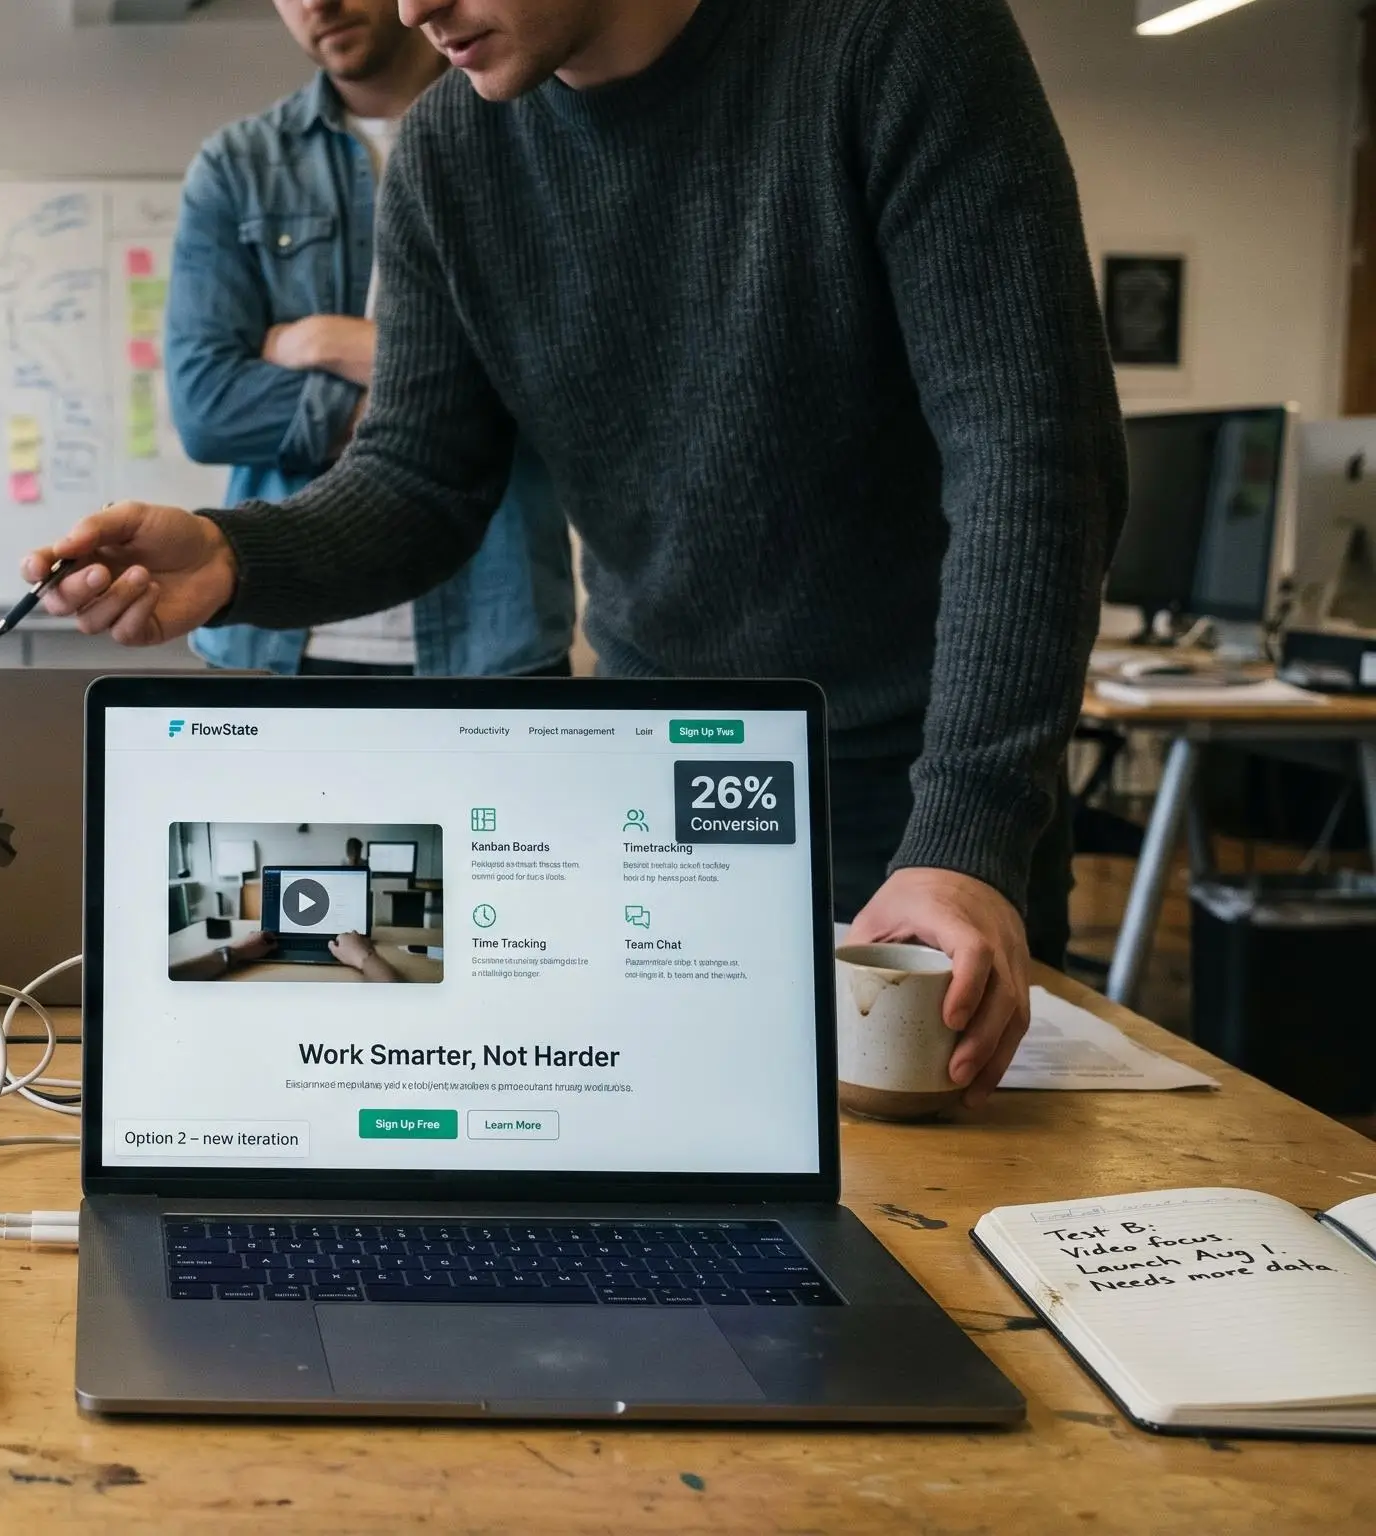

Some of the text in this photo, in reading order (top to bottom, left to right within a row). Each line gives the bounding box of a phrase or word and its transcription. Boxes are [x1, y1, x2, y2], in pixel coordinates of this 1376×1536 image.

[192, 723, 258, 735] FlowState
[460, 727, 510, 736] Productivity
[529, 727, 614, 736] Project management
[680, 727, 699, 737] Sign
[702, 728, 714, 737] Up
[692, 776, 776, 809] 26%
[691, 817, 778, 831] Conversion
[472, 842, 549, 851] Kanban Boards
[623, 843, 693, 855] Timetracking
[472, 938, 546, 951] Time Tracking
[625, 940, 681, 949] Team Chat
[299, 1044, 620, 1070] Work Smarter, Not Harder
[376, 1119, 440, 1130] Sign Up Free
[485, 1120, 541, 1129] Learn More
[125, 1132, 172, 1147] Option
[178, 1132, 185, 1144] 2
[204, 1135, 233, 1144] new
[238, 1133, 298, 1145] iteration
[1043, 1222, 1156, 1244] Test B:
[1060, 1232, 1233, 1258] Video focus.
[1076, 1255, 1180, 1275] Launch
[1196, 1250, 1254, 1263] Aug
[1087, 1272, 1175, 1291] Needs
[1188, 1268, 1253, 1280] more
